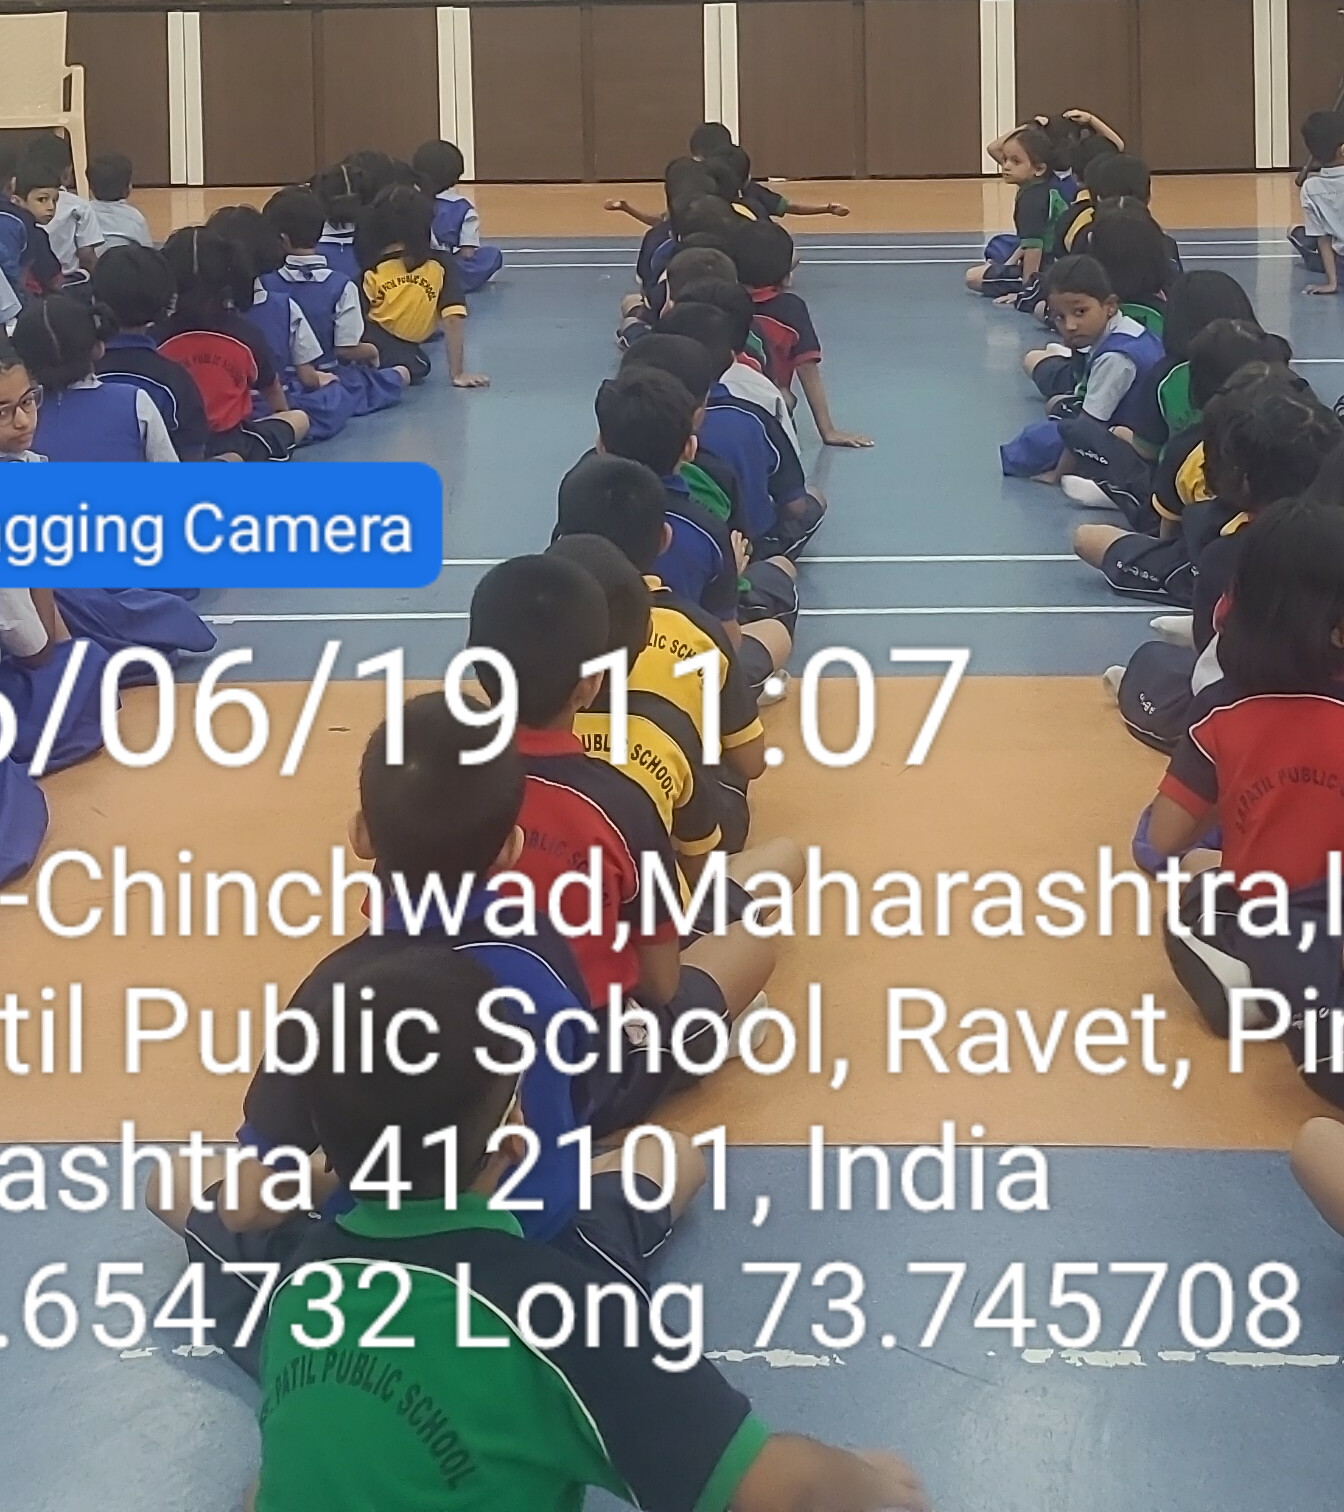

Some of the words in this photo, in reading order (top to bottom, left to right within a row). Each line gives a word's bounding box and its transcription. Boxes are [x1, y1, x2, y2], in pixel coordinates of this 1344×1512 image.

[630, 743, 674, 801] SCHOOL
[1278, 765, 1339, 790] PUBLIC
[274, 1351, 317, 1406] PATIL
[321, 1347, 403, 1404] PUBLIC
[396, 1381, 479, 1492] SCHOOL
